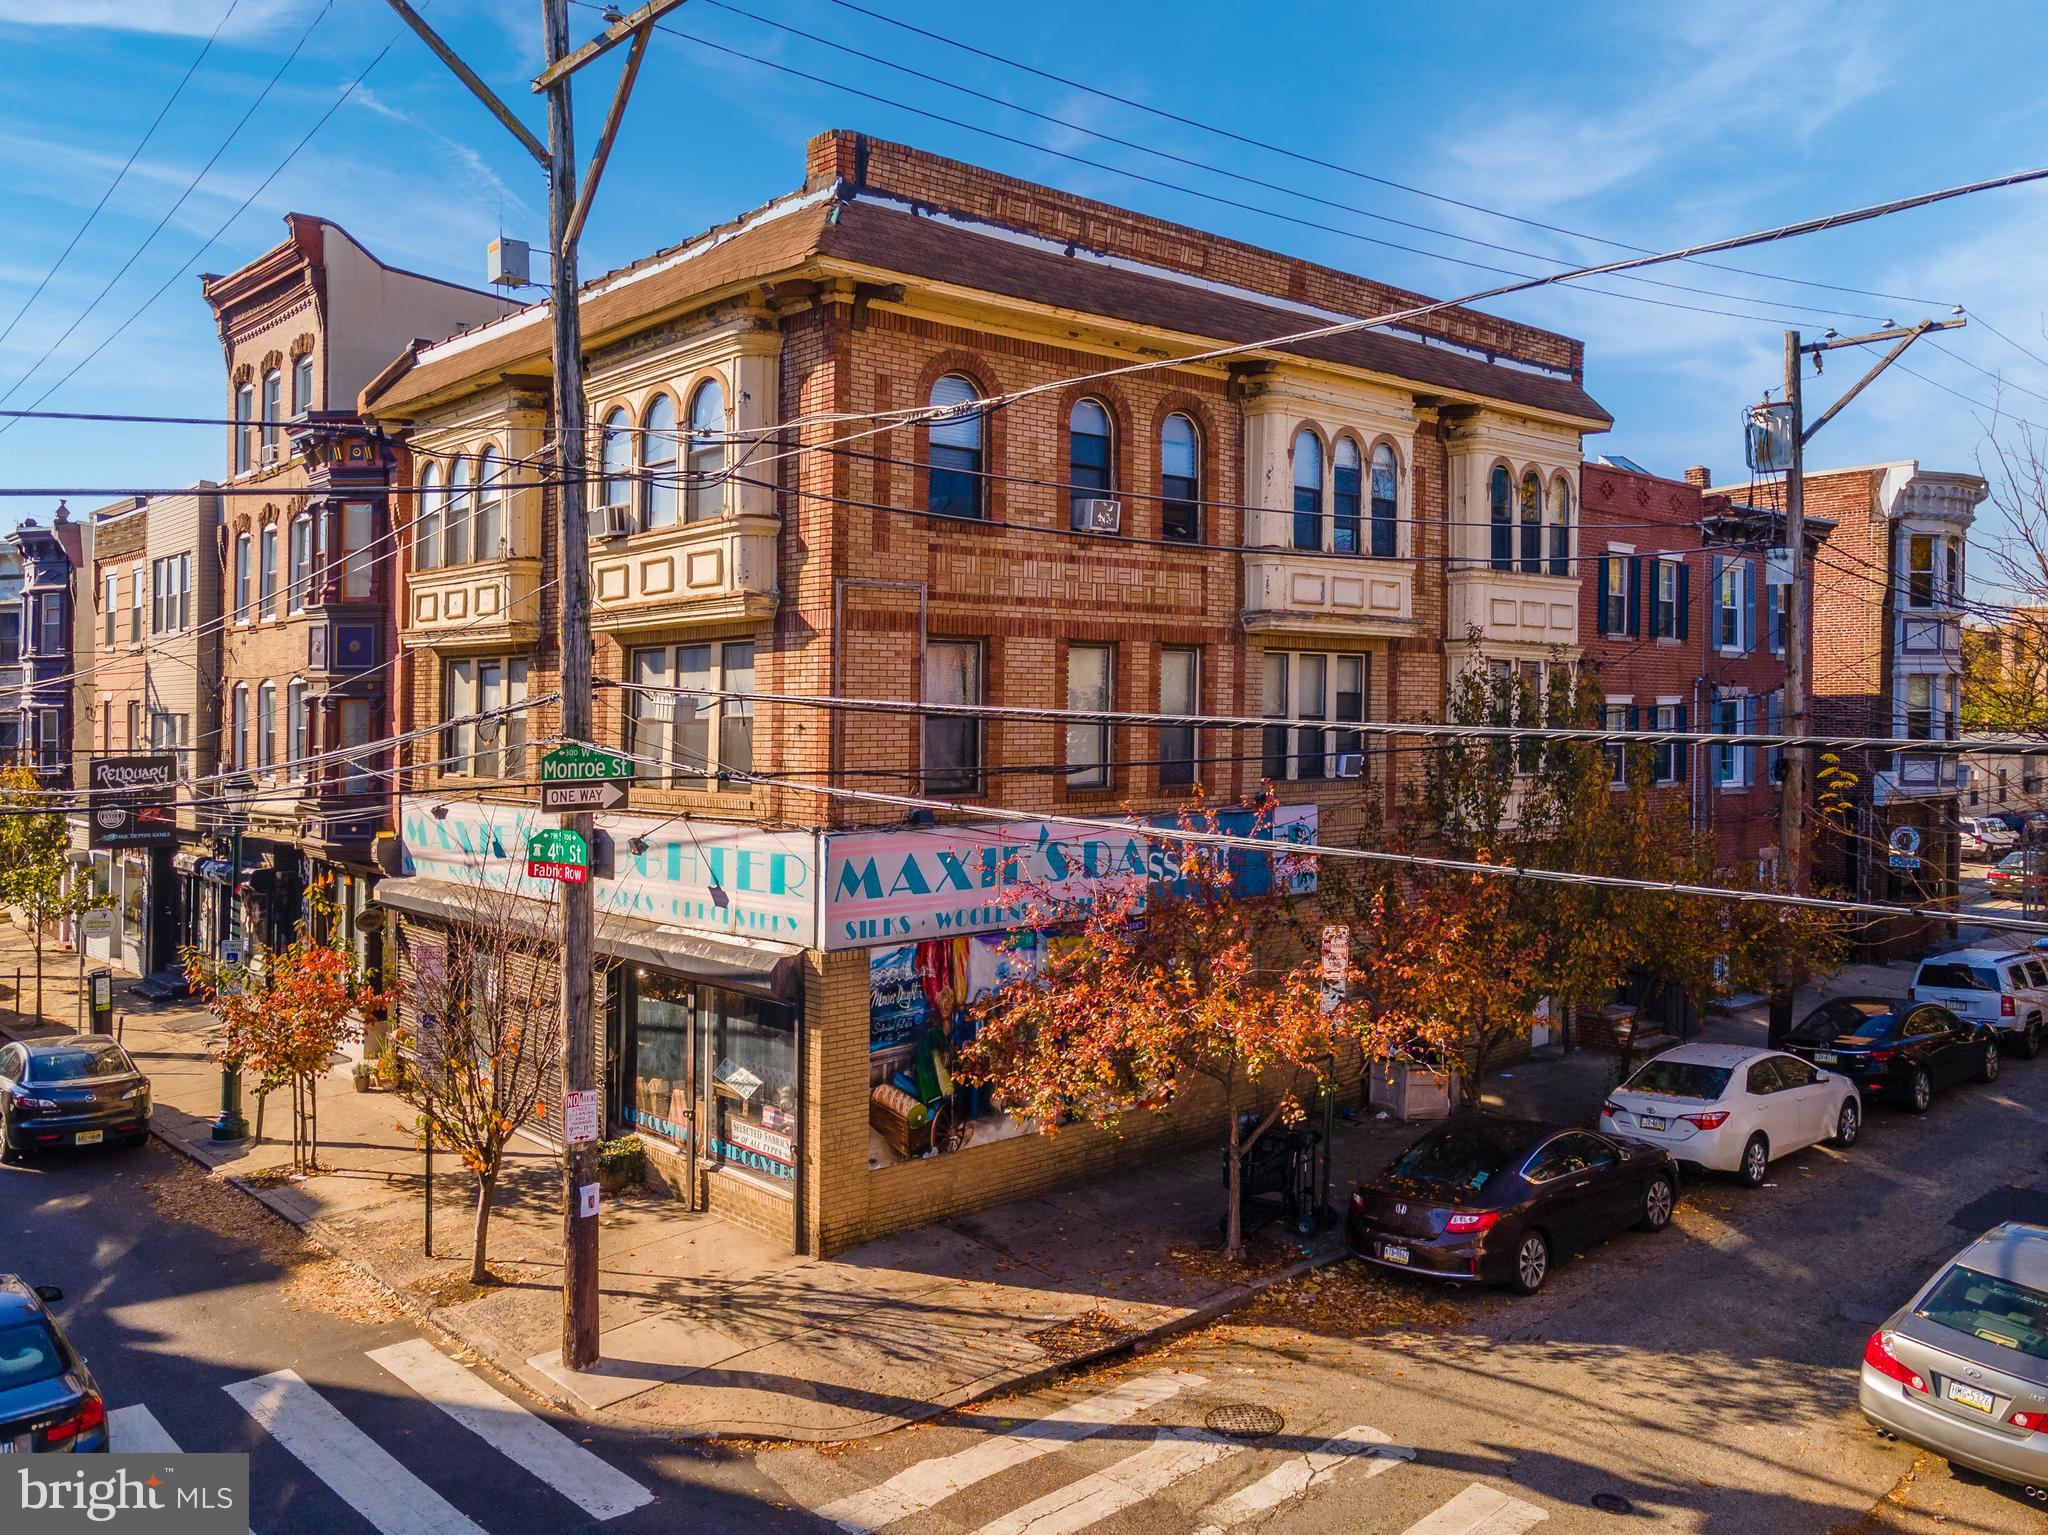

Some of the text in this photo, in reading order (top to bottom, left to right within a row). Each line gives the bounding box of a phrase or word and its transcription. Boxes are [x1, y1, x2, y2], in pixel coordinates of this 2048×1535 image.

[581, 747, 590, 757] W
[544, 758, 628, 779] Monroe St
[551, 789, 603, 804] ONE WAY
[547, 842, 581, 864] 4th St
[533, 863, 582, 881] Fabric Row
[834, 824, 1070, 903] MAXIE'S
[844, 915, 911, 941] SILKS
[567, 1094, 579, 1108] NO
[733, 1123, 790, 1150] SELECTED FABRICS
[740, 1136, 782, 1156] OF ALL TYPES
